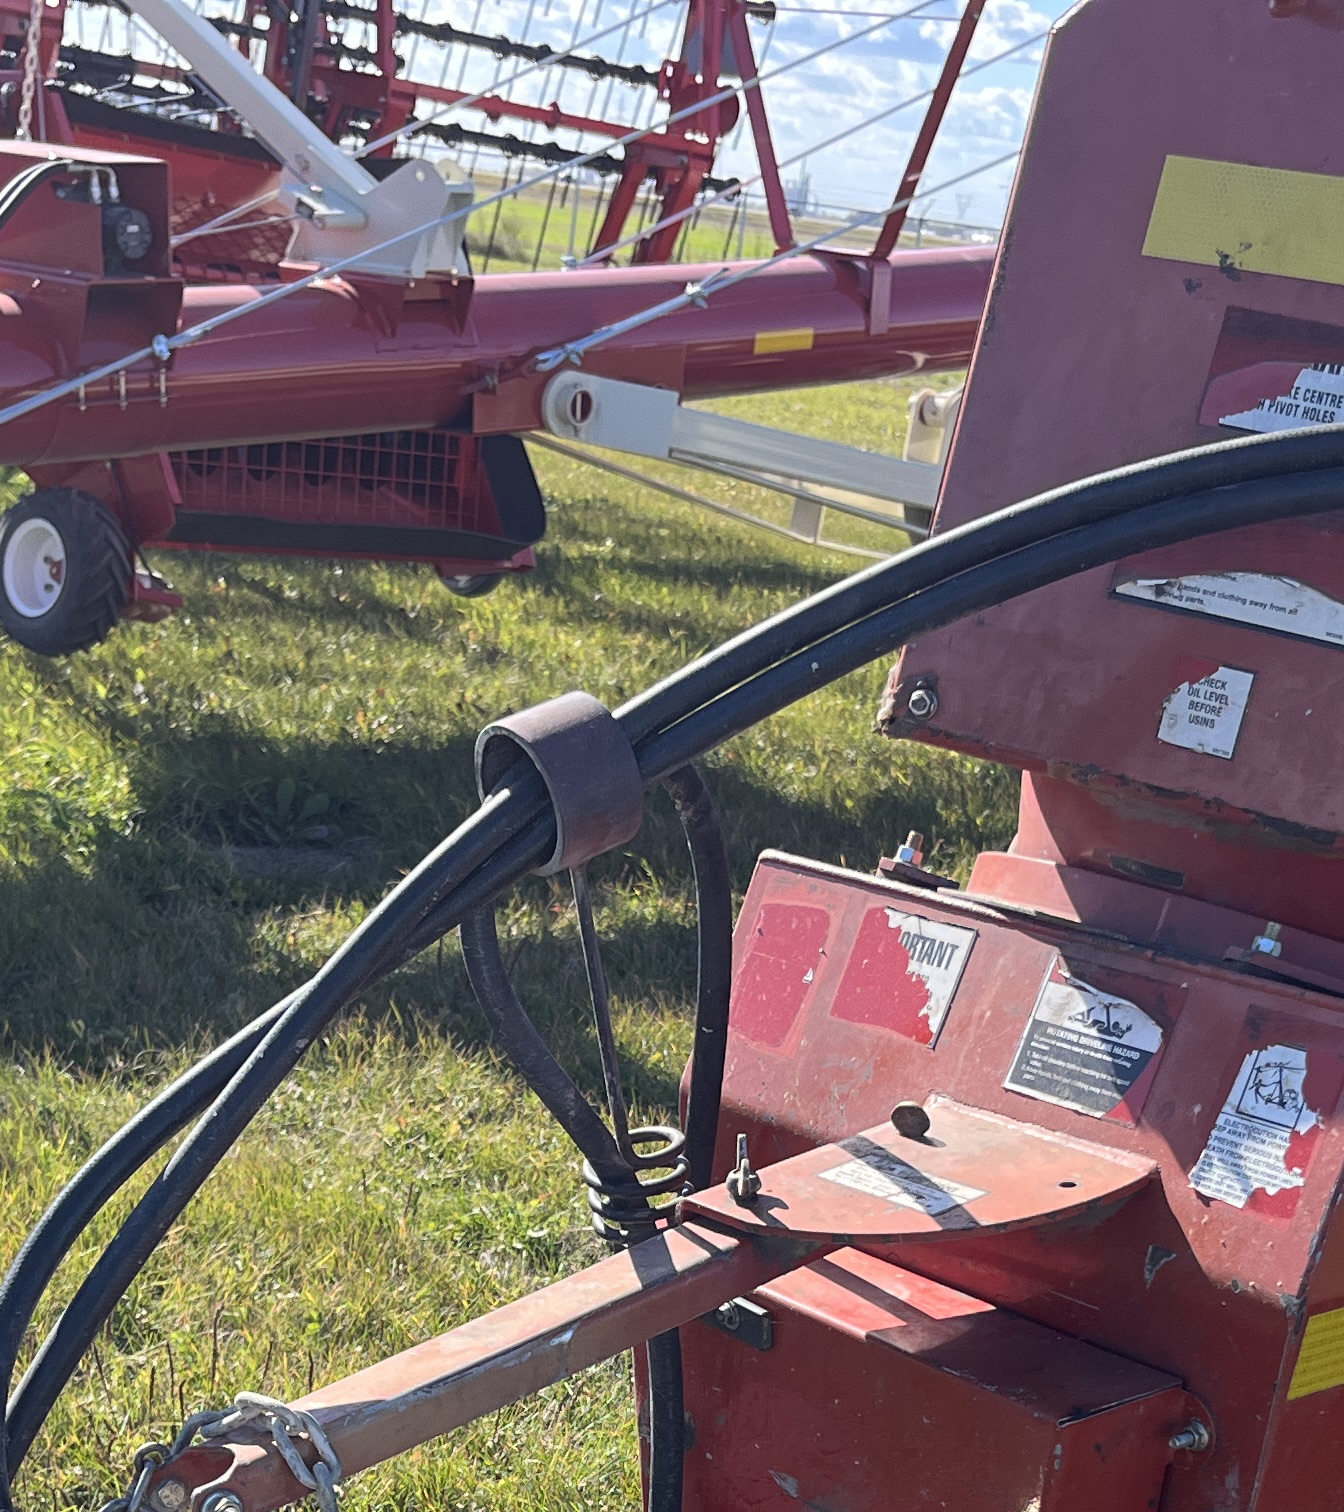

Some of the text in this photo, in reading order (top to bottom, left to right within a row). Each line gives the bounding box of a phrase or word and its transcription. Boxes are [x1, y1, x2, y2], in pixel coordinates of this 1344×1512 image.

[1302, 388, 1344, 408] CENTRE
[1267, 399, 1299, 417] PIVOT
[1301, 406, 1335, 423] HOLES
[1217, 591, 1247, 605] clothing
[1268, 602, 1287, 613] from
[1187, 687, 1229, 706] OIL LEVEL
[1188, 701, 1223, 717] BEFORE
[1112, 1046, 1140, 1060] HAZARD
[1227, 1128, 1246, 1138] AWAY
[1213, 1136, 1242, 1150] PREVENT
[1244, 1145, 1272, 1159] SERIOUS
[1225, 1150, 1244, 1160] FROM
